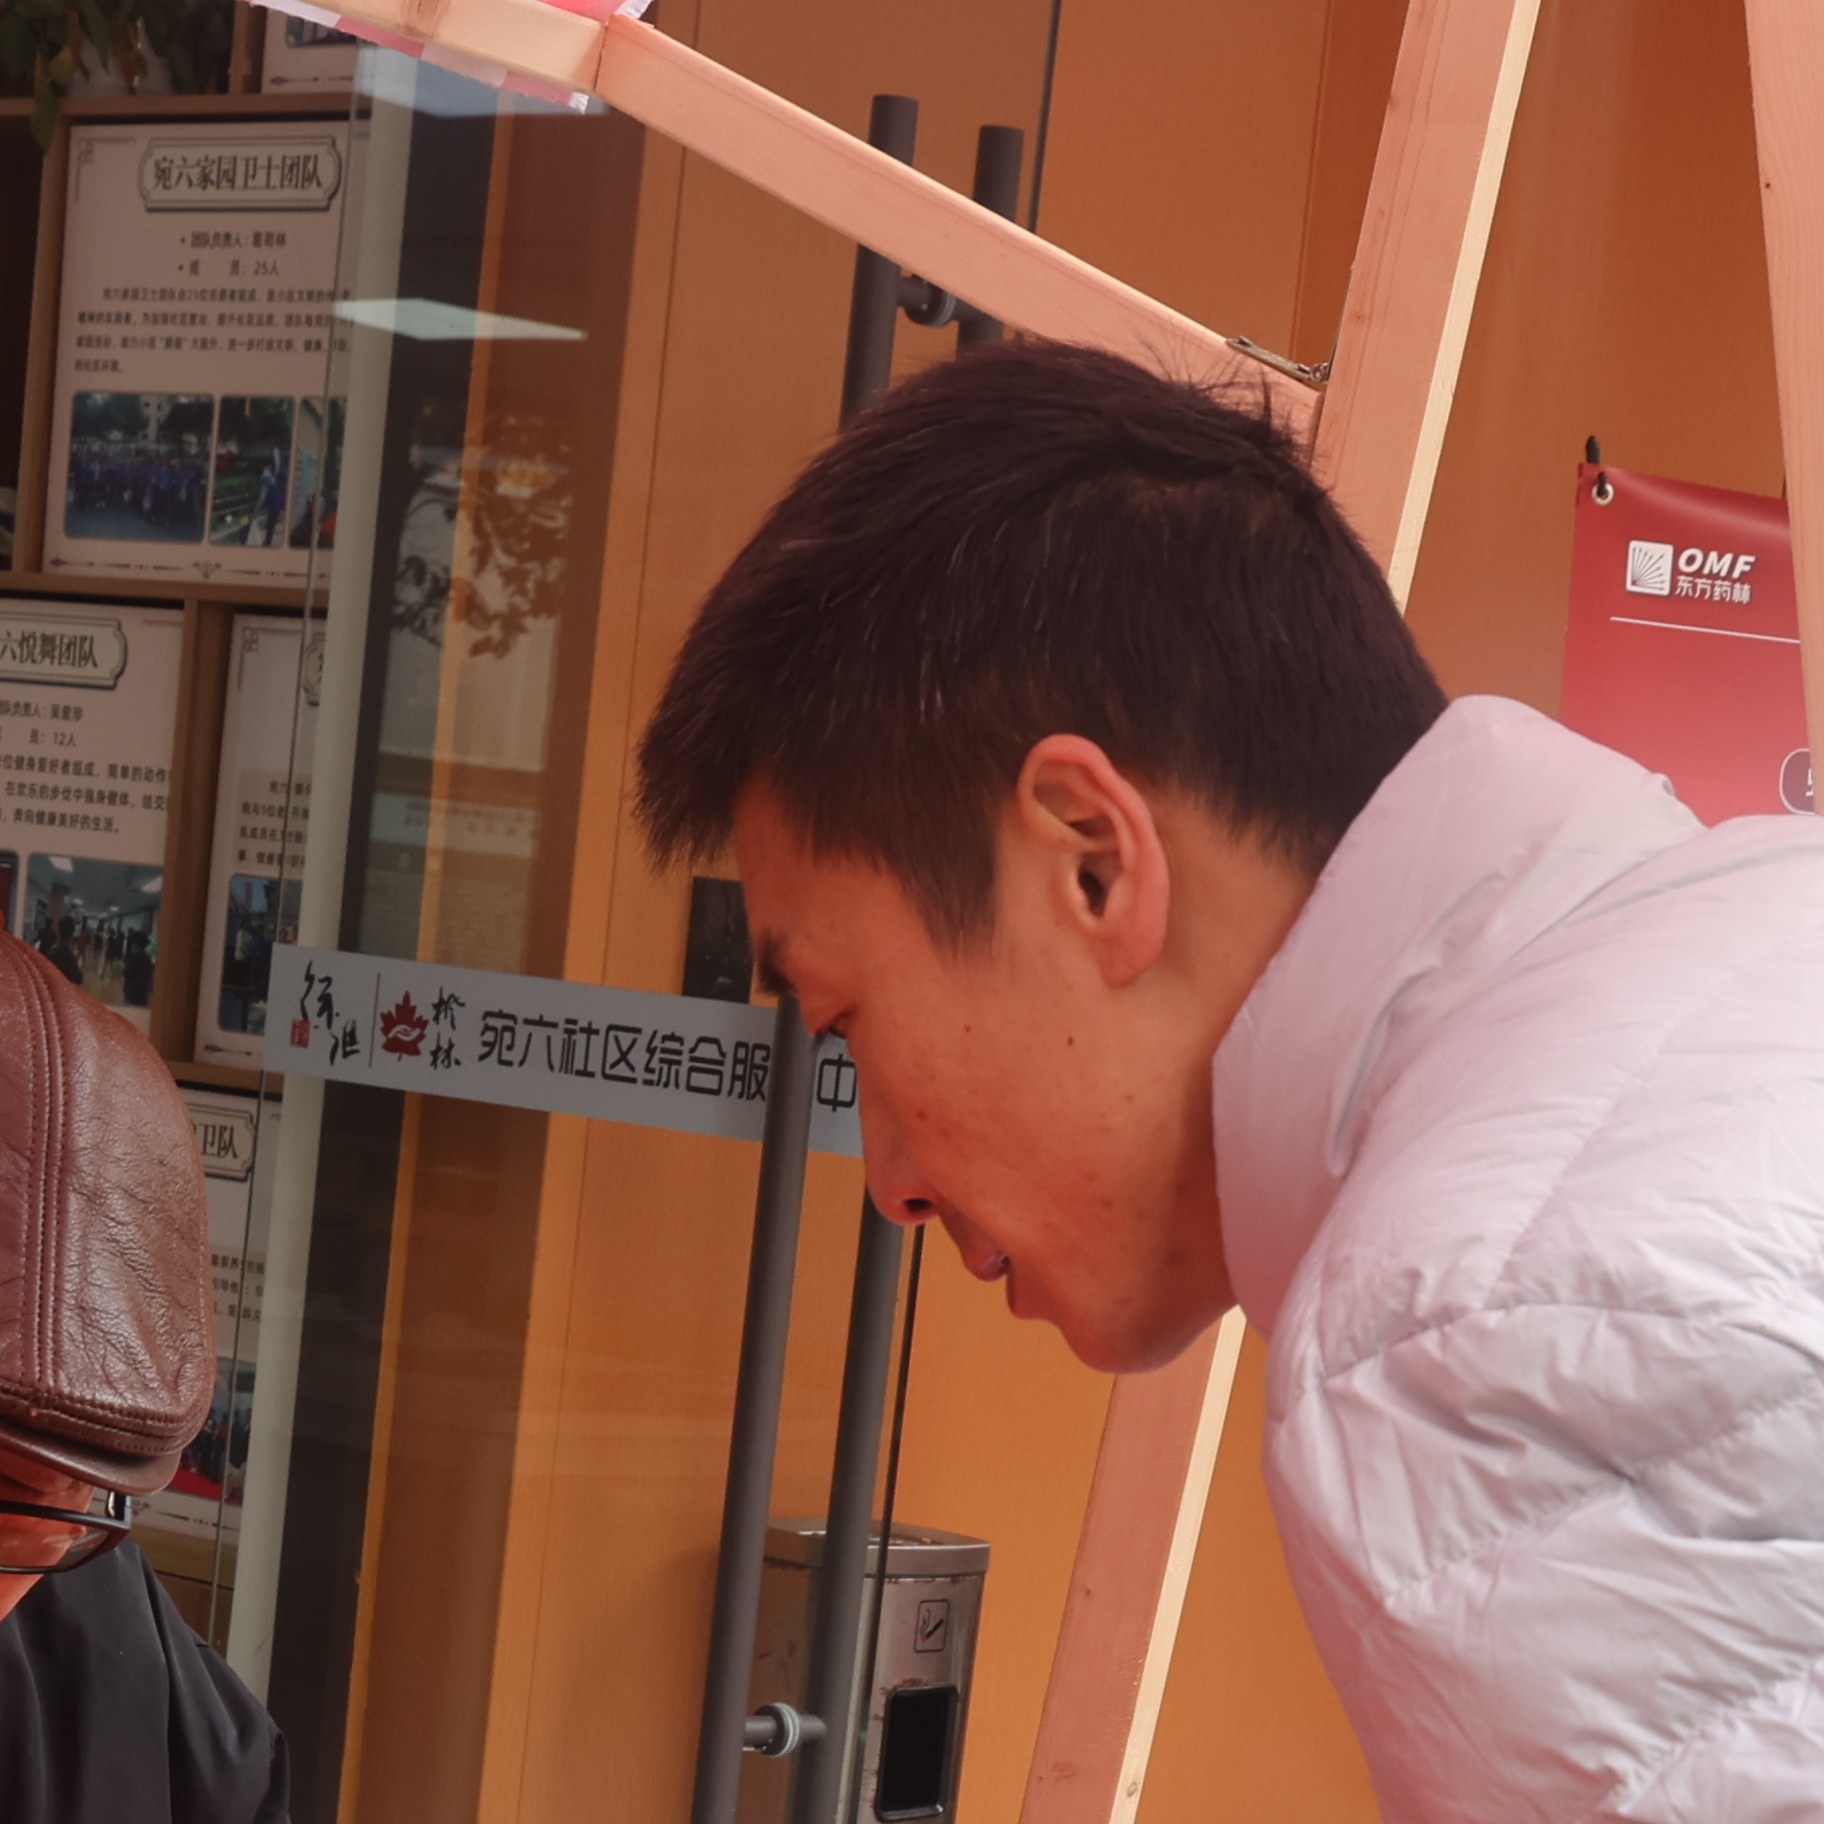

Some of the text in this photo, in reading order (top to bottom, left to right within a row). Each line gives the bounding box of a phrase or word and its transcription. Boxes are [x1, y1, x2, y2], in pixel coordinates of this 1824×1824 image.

[152, 154, 323, 192] 宛六家园卫士团队
[1678, 547, 1756, 578] OMF
[1675, 575, 1752, 604] 东方药林
[478, 1007, 857, 1113] 宛六社区综合服中
